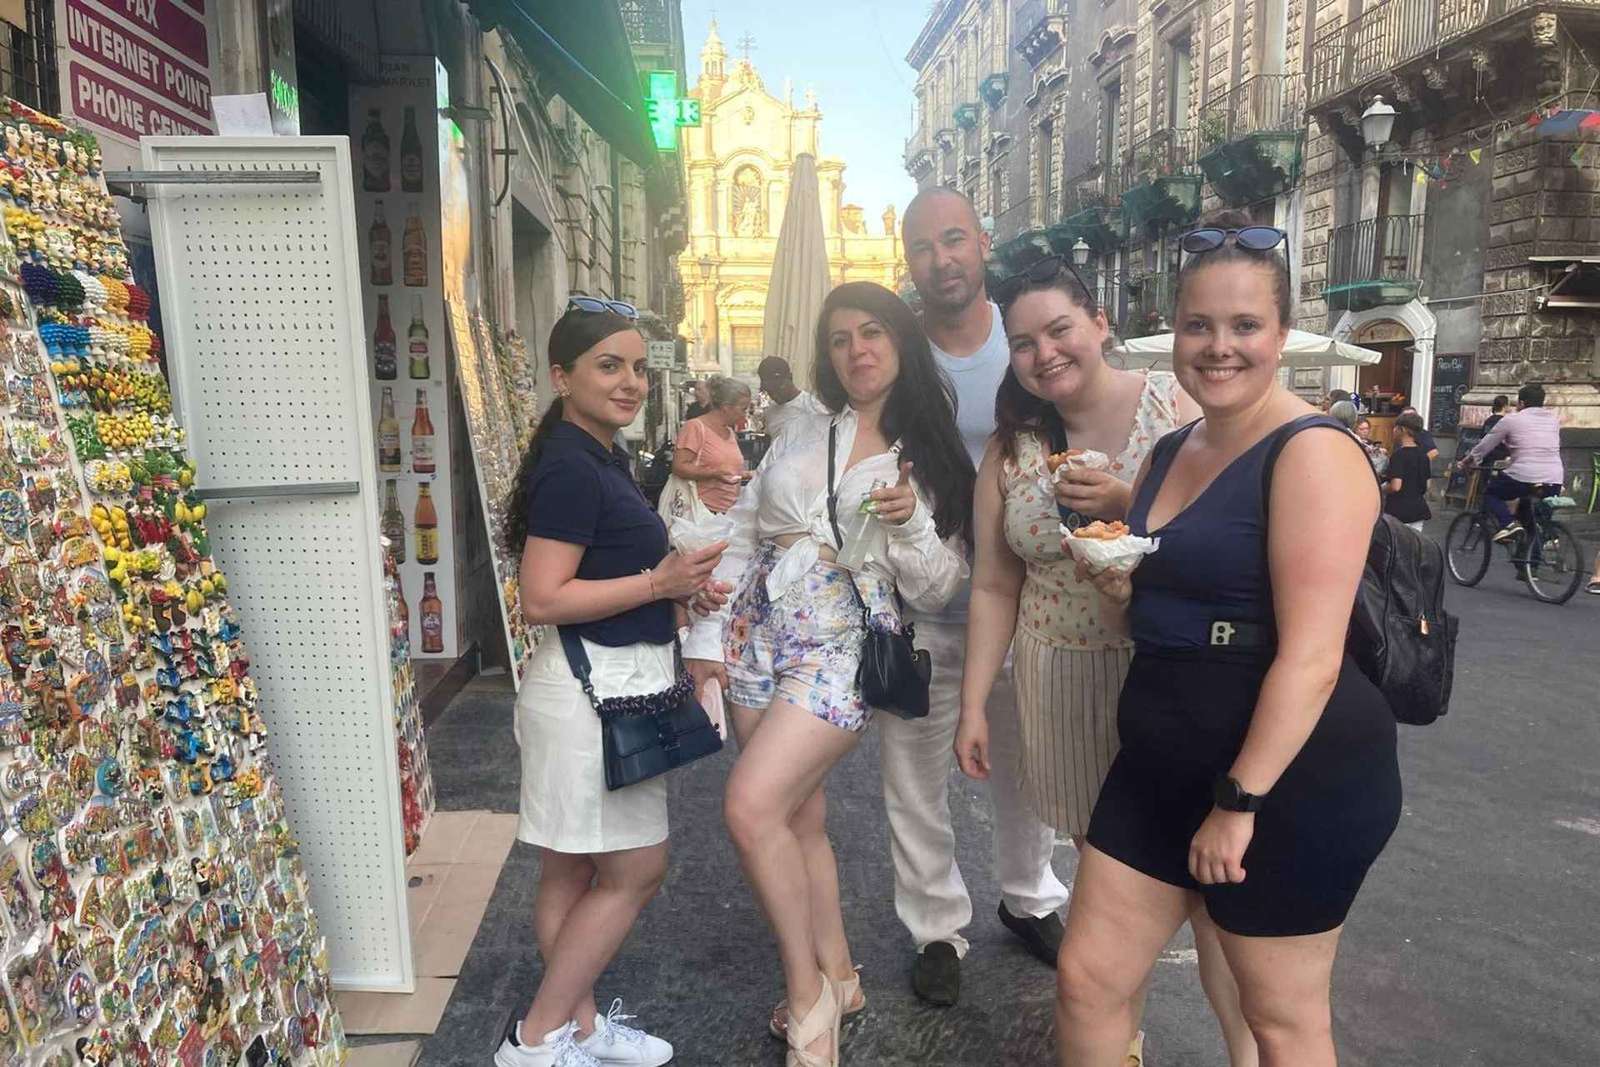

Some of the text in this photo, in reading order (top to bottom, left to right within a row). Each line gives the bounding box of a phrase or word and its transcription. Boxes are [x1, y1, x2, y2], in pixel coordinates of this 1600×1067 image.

[68, 5, 159, 84] INTERNET
[164, 61, 210, 111] POINT
[78, 74, 145, 134] PHONE
